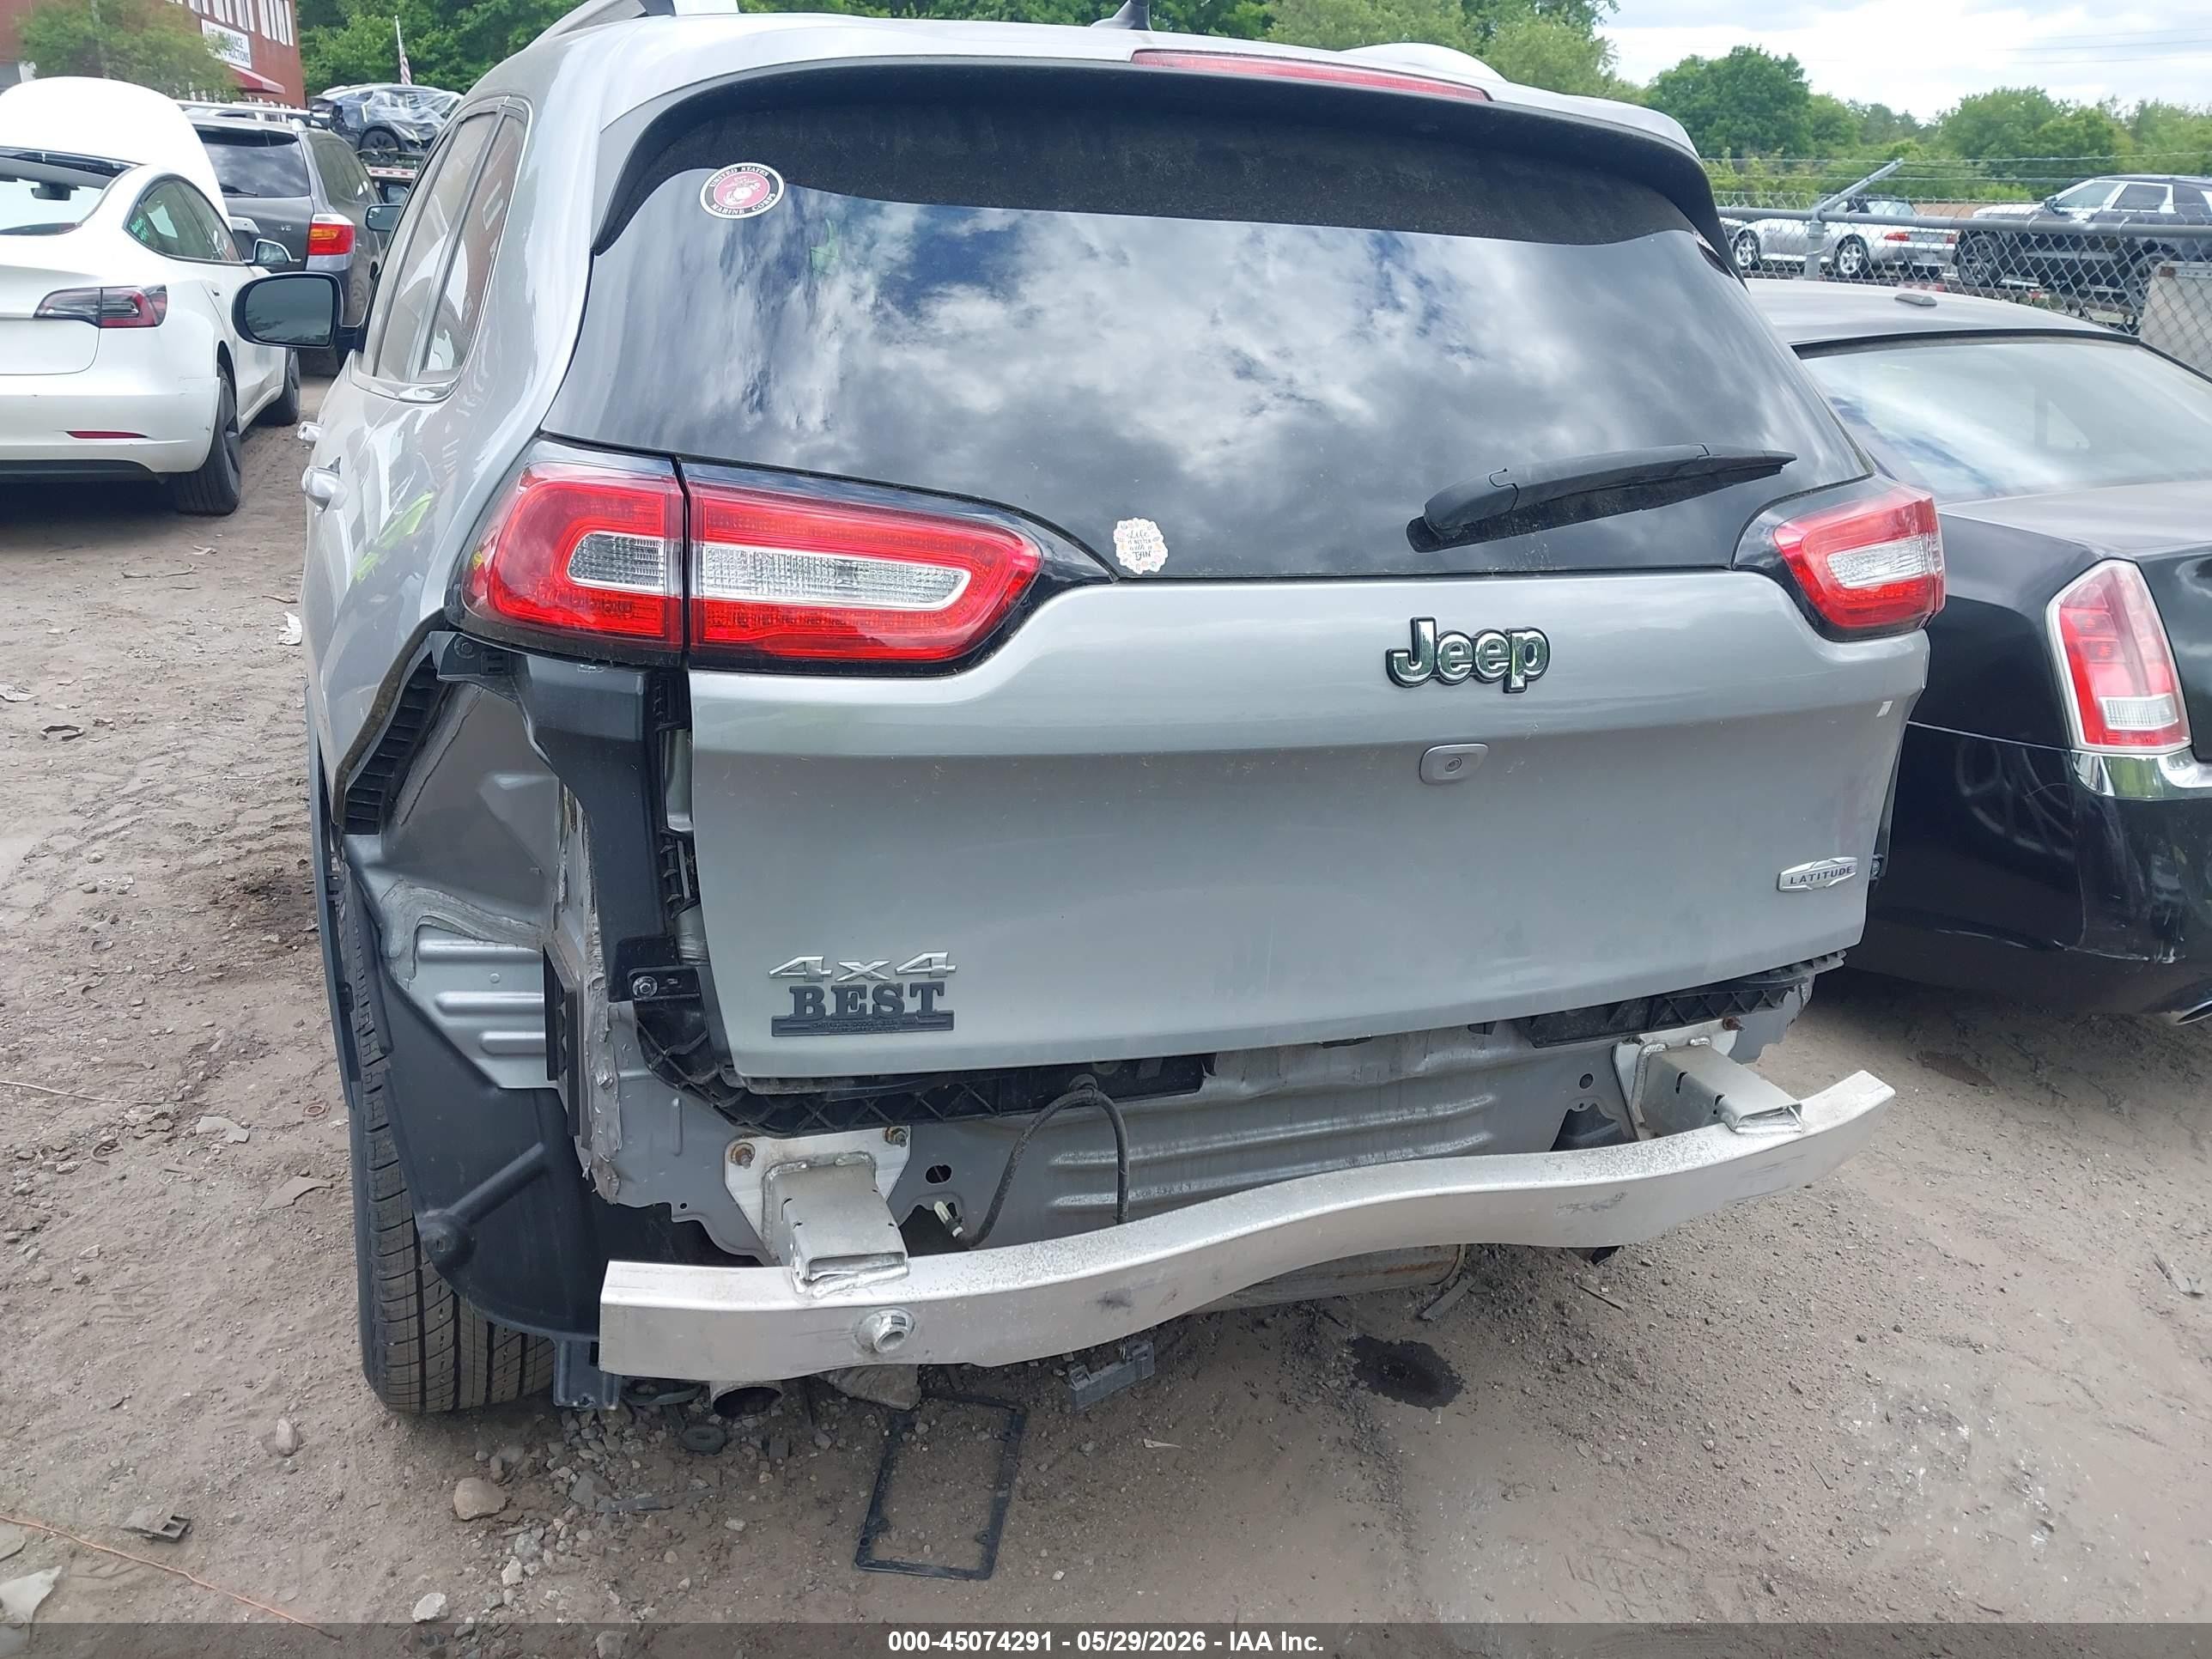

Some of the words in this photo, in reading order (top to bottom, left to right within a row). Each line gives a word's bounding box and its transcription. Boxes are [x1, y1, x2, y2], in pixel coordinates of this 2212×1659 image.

[709, 168, 738, 187] UNITED
[741, 166, 769, 177] STATES
[711, 204, 745, 216] MARINE
[751, 192, 776, 211] CORPS
[1386, 617, 1551, 694] Jeep
[1790, 865, 1853, 884] LATITUDE
[769, 951, 957, 982] 4x4
[788, 981, 945, 1022] BEST
